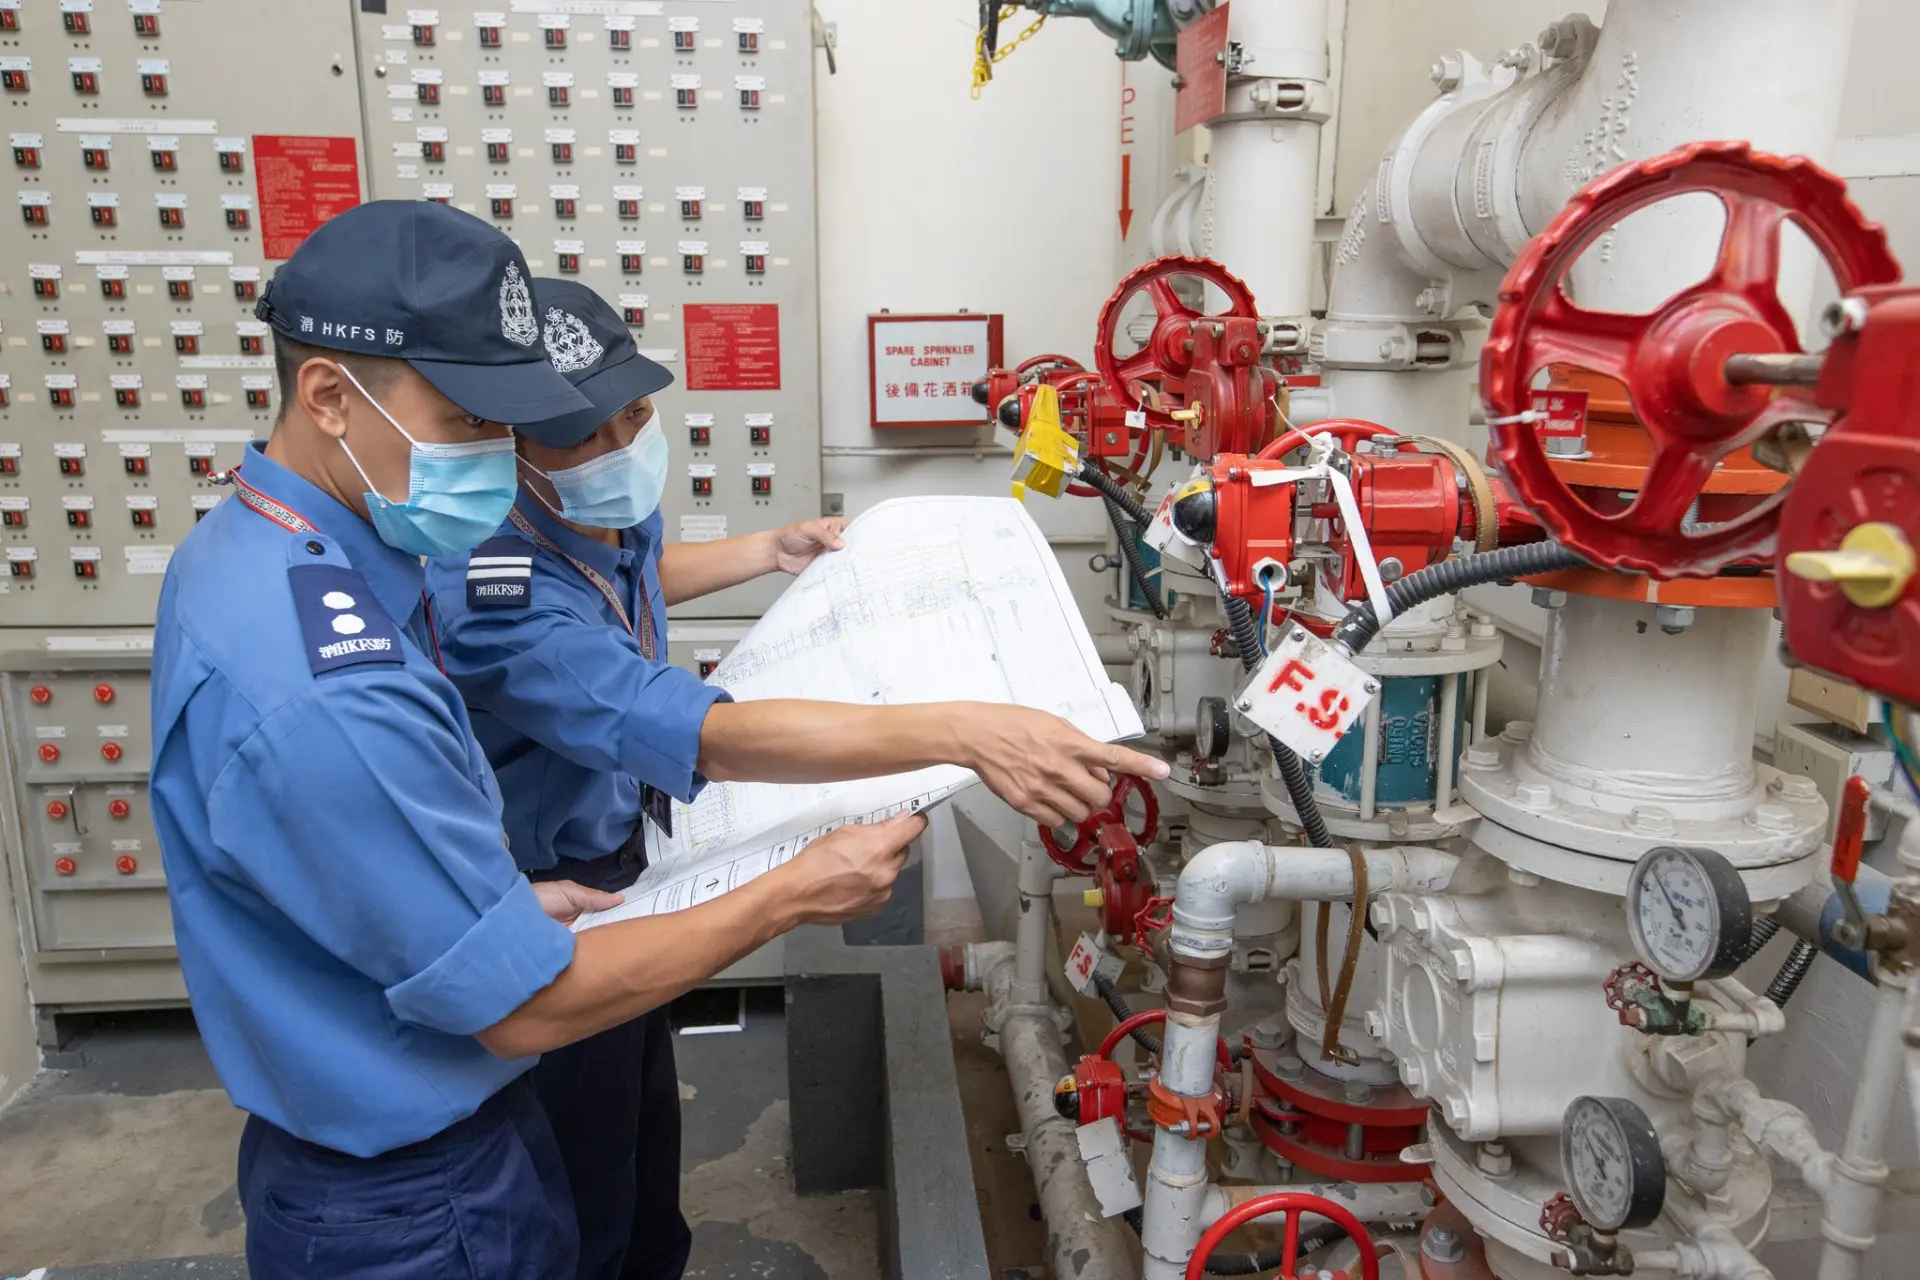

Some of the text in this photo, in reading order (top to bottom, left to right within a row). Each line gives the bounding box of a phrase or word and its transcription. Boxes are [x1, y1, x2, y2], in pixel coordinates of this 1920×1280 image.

[322, 321, 376, 341] HKFS
[385, 328, 404, 346] 防
[885, 345, 975, 356] SPARE SPRINKLER
[911, 357, 951, 367] CABINET
[254, 496, 297, 525] SERVICES
